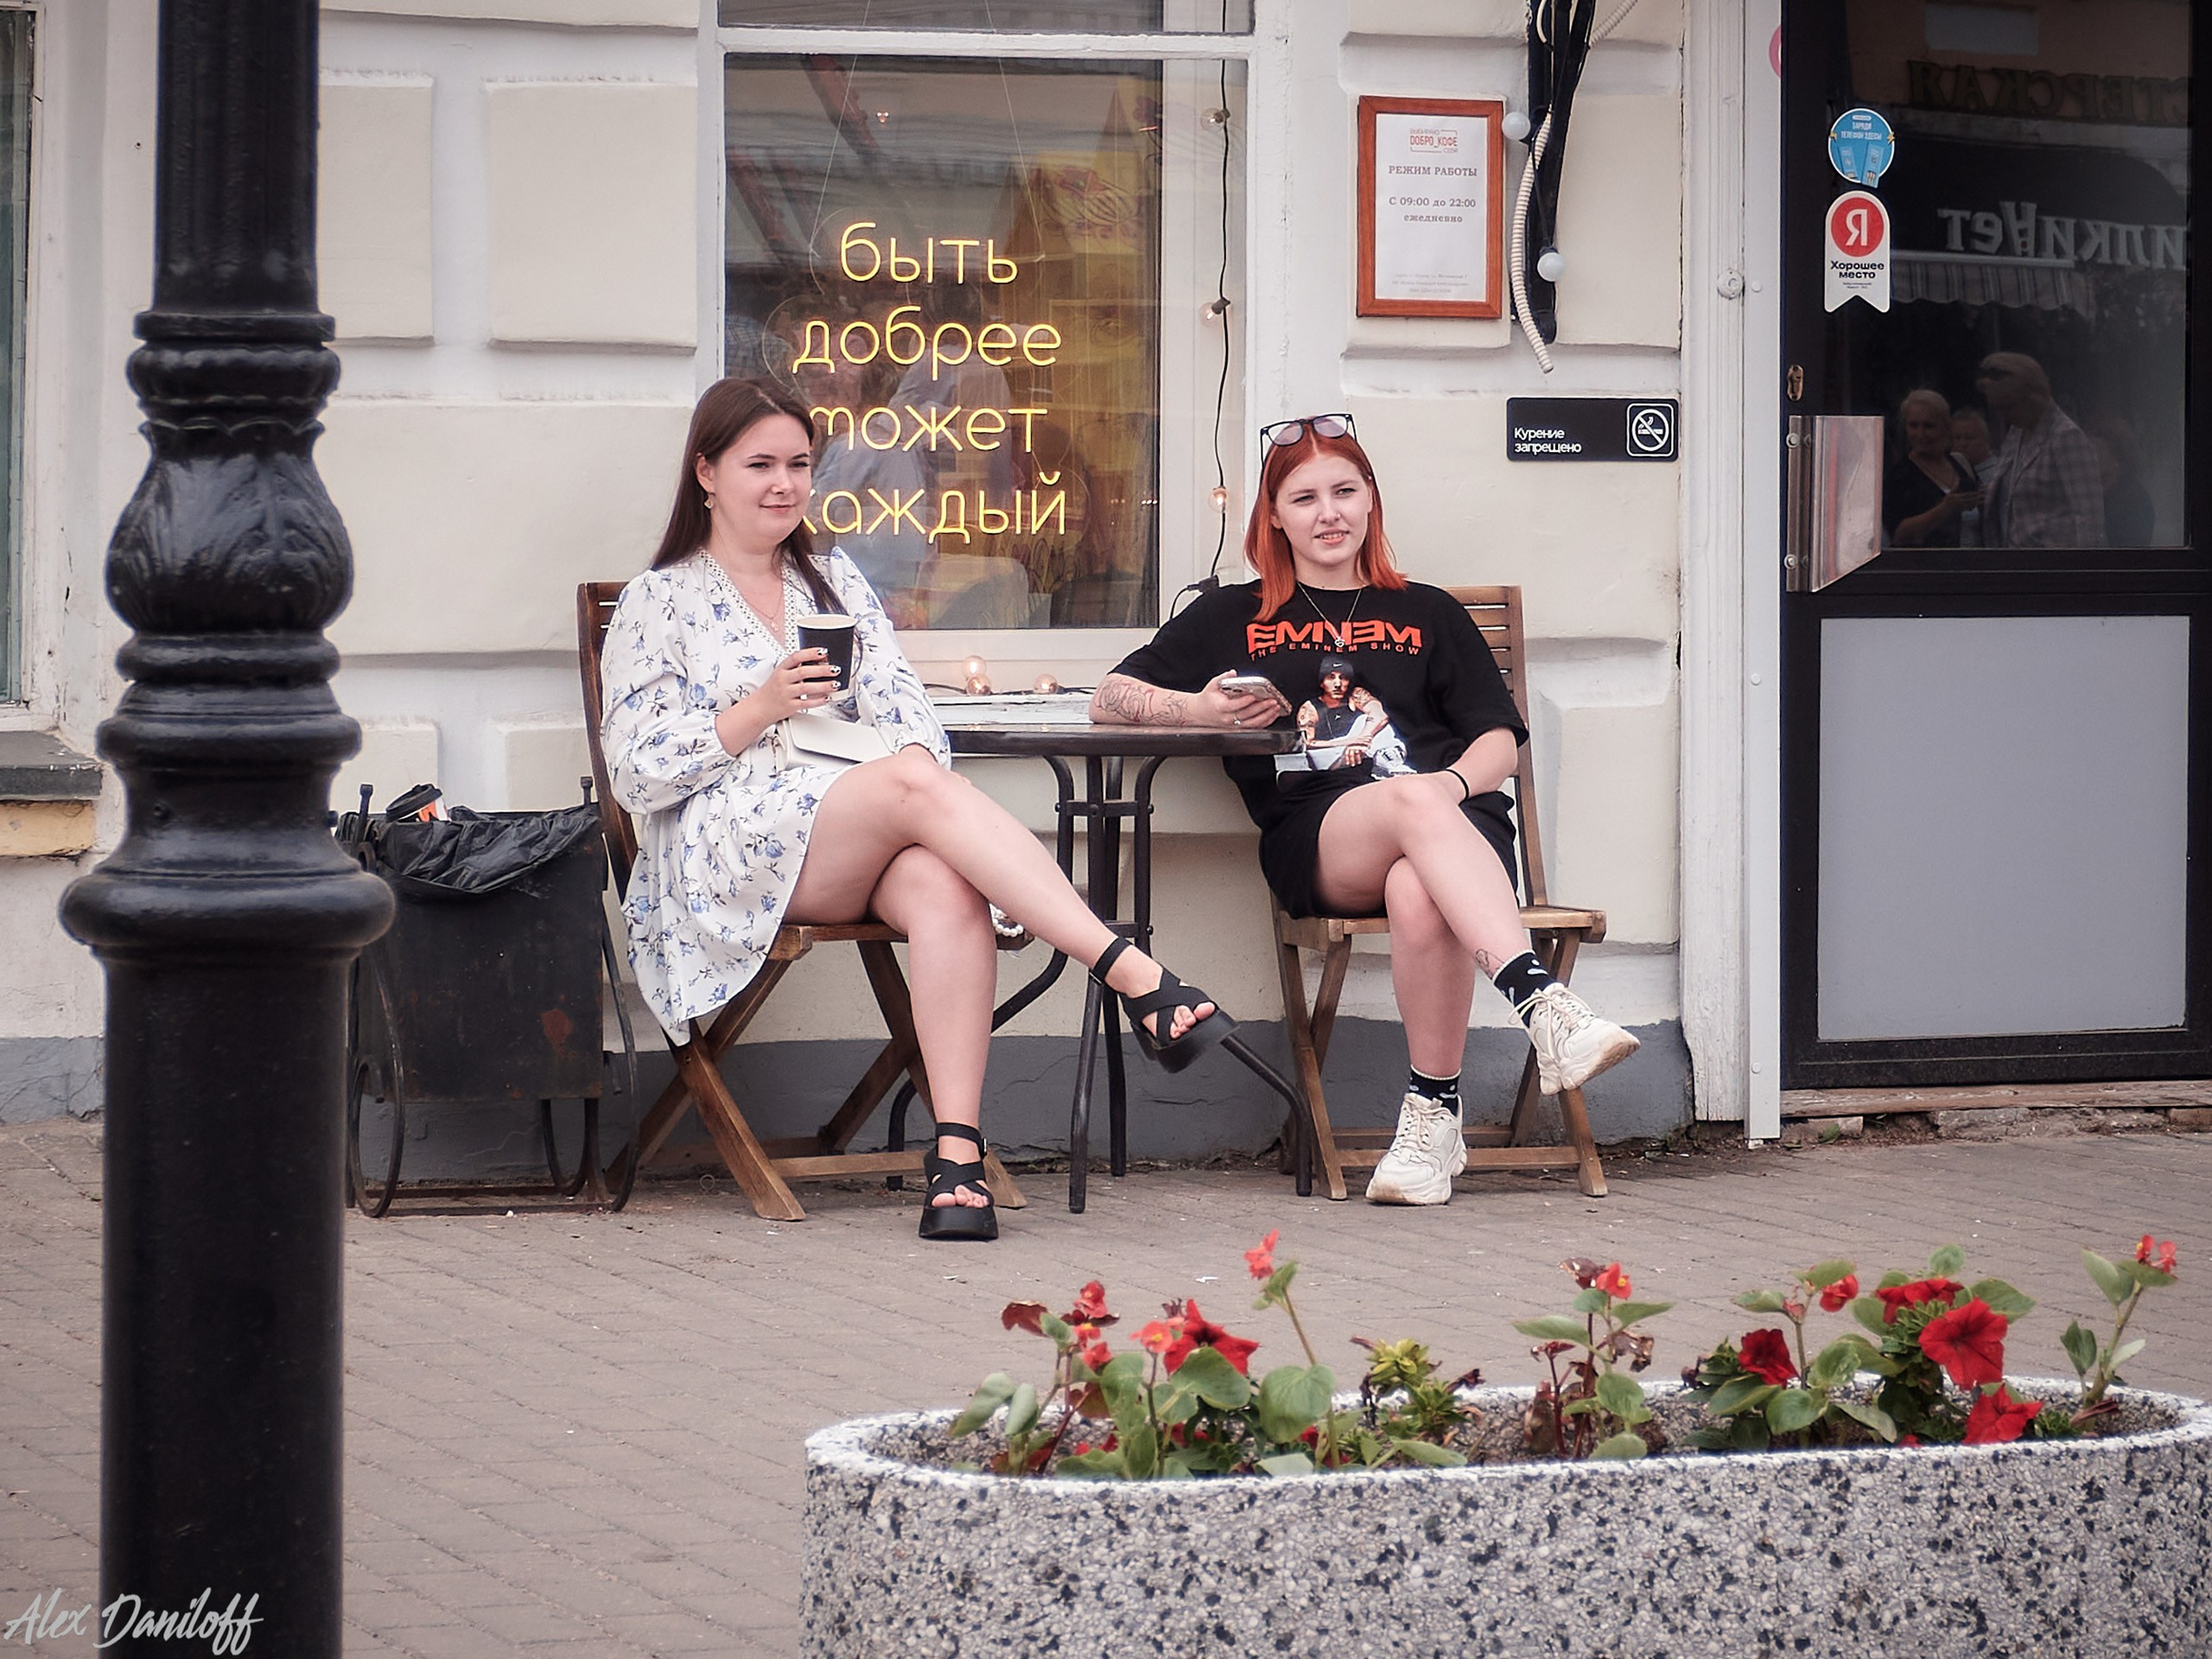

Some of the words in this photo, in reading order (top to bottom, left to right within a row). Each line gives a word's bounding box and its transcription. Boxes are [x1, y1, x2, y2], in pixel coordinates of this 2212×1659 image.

[1389, 165, 1431, 175] РЕЖИМ
[1434, 166, 1478, 176] РАБОТЫ
[1400, 197, 1430, 206] 09:00
[1449, 198, 1477, 207] 22:00
[1403, 214, 1463, 223] ежедневно
[1846, 208, 1868, 246] Я
[841, 221, 1019, 284] быть
[1830, 260, 1885, 271] Хорошее
[791, 305, 1062, 381] добрее
[1514, 427, 1566, 442] Курение
[1514, 442, 1582, 455] запрещено
[1246, 620, 1423, 655] EMINEM
[1250, 646, 1277, 662] THE
[1288, 642, 1357, 654] EMINEM
[1370, 642, 1421, 656] SHOW
